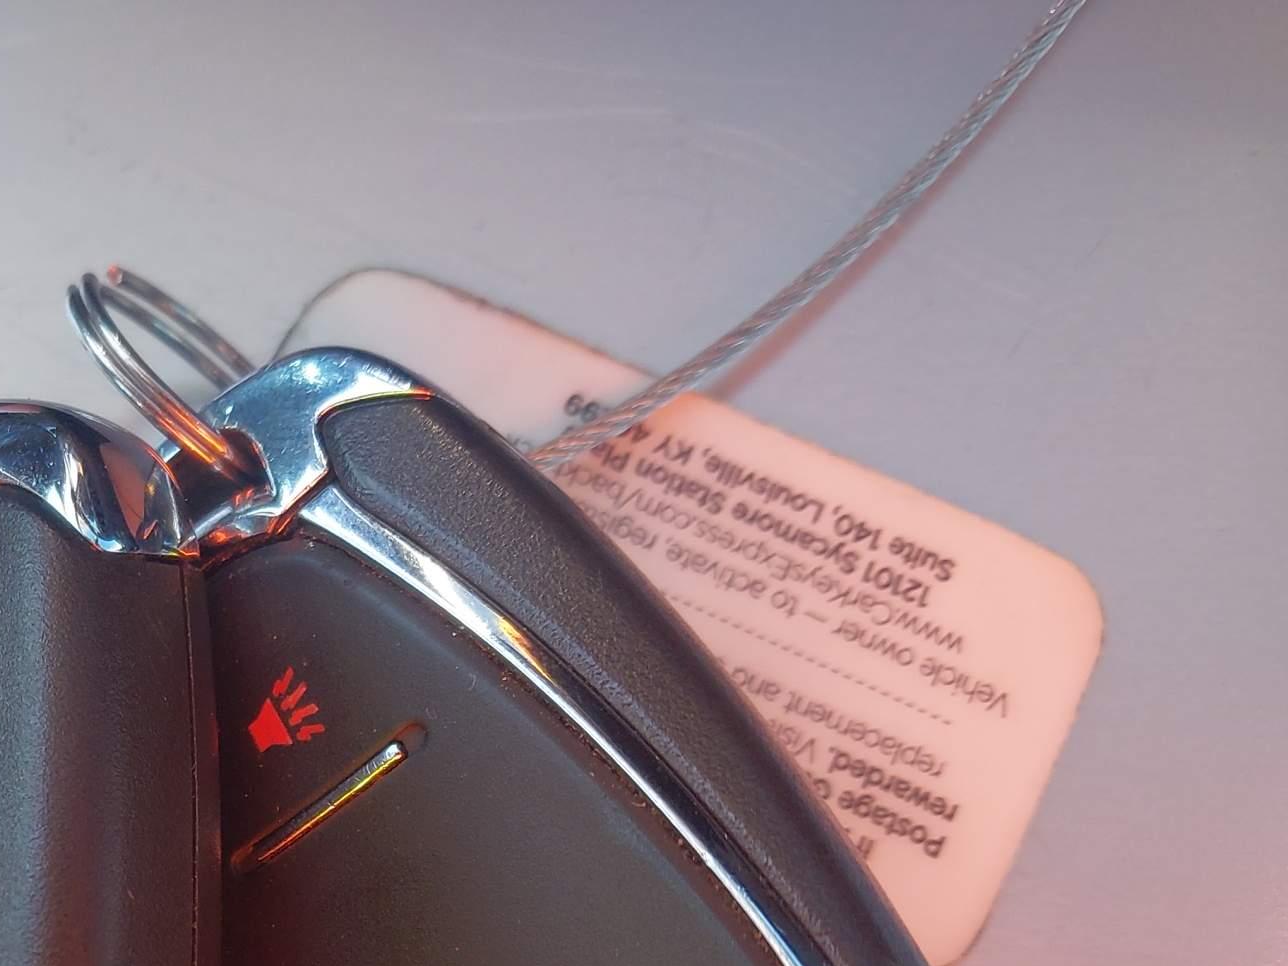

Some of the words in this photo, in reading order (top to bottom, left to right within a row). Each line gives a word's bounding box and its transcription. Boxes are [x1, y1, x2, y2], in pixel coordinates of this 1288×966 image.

[652, 433, 696, 466] KY
[634, 456, 727, 516] Station
[700, 447, 827, 525] Louisville,
[731, 501, 861, 575] Sycamore
[832, 504, 883, 551] 140,
[664, 536, 767, 600] activate,
[862, 560, 932, 609] 12101
[888, 536, 957, 582] Suite
[769, 589, 799, 619] to
[831, 620, 913, 667] owner
[919, 656, 1010, 719] Vehicle
[784, 690, 946, 777] replacement
[827, 746, 960, 822] rewarded.
[838, 789, 947, 859] Postage
